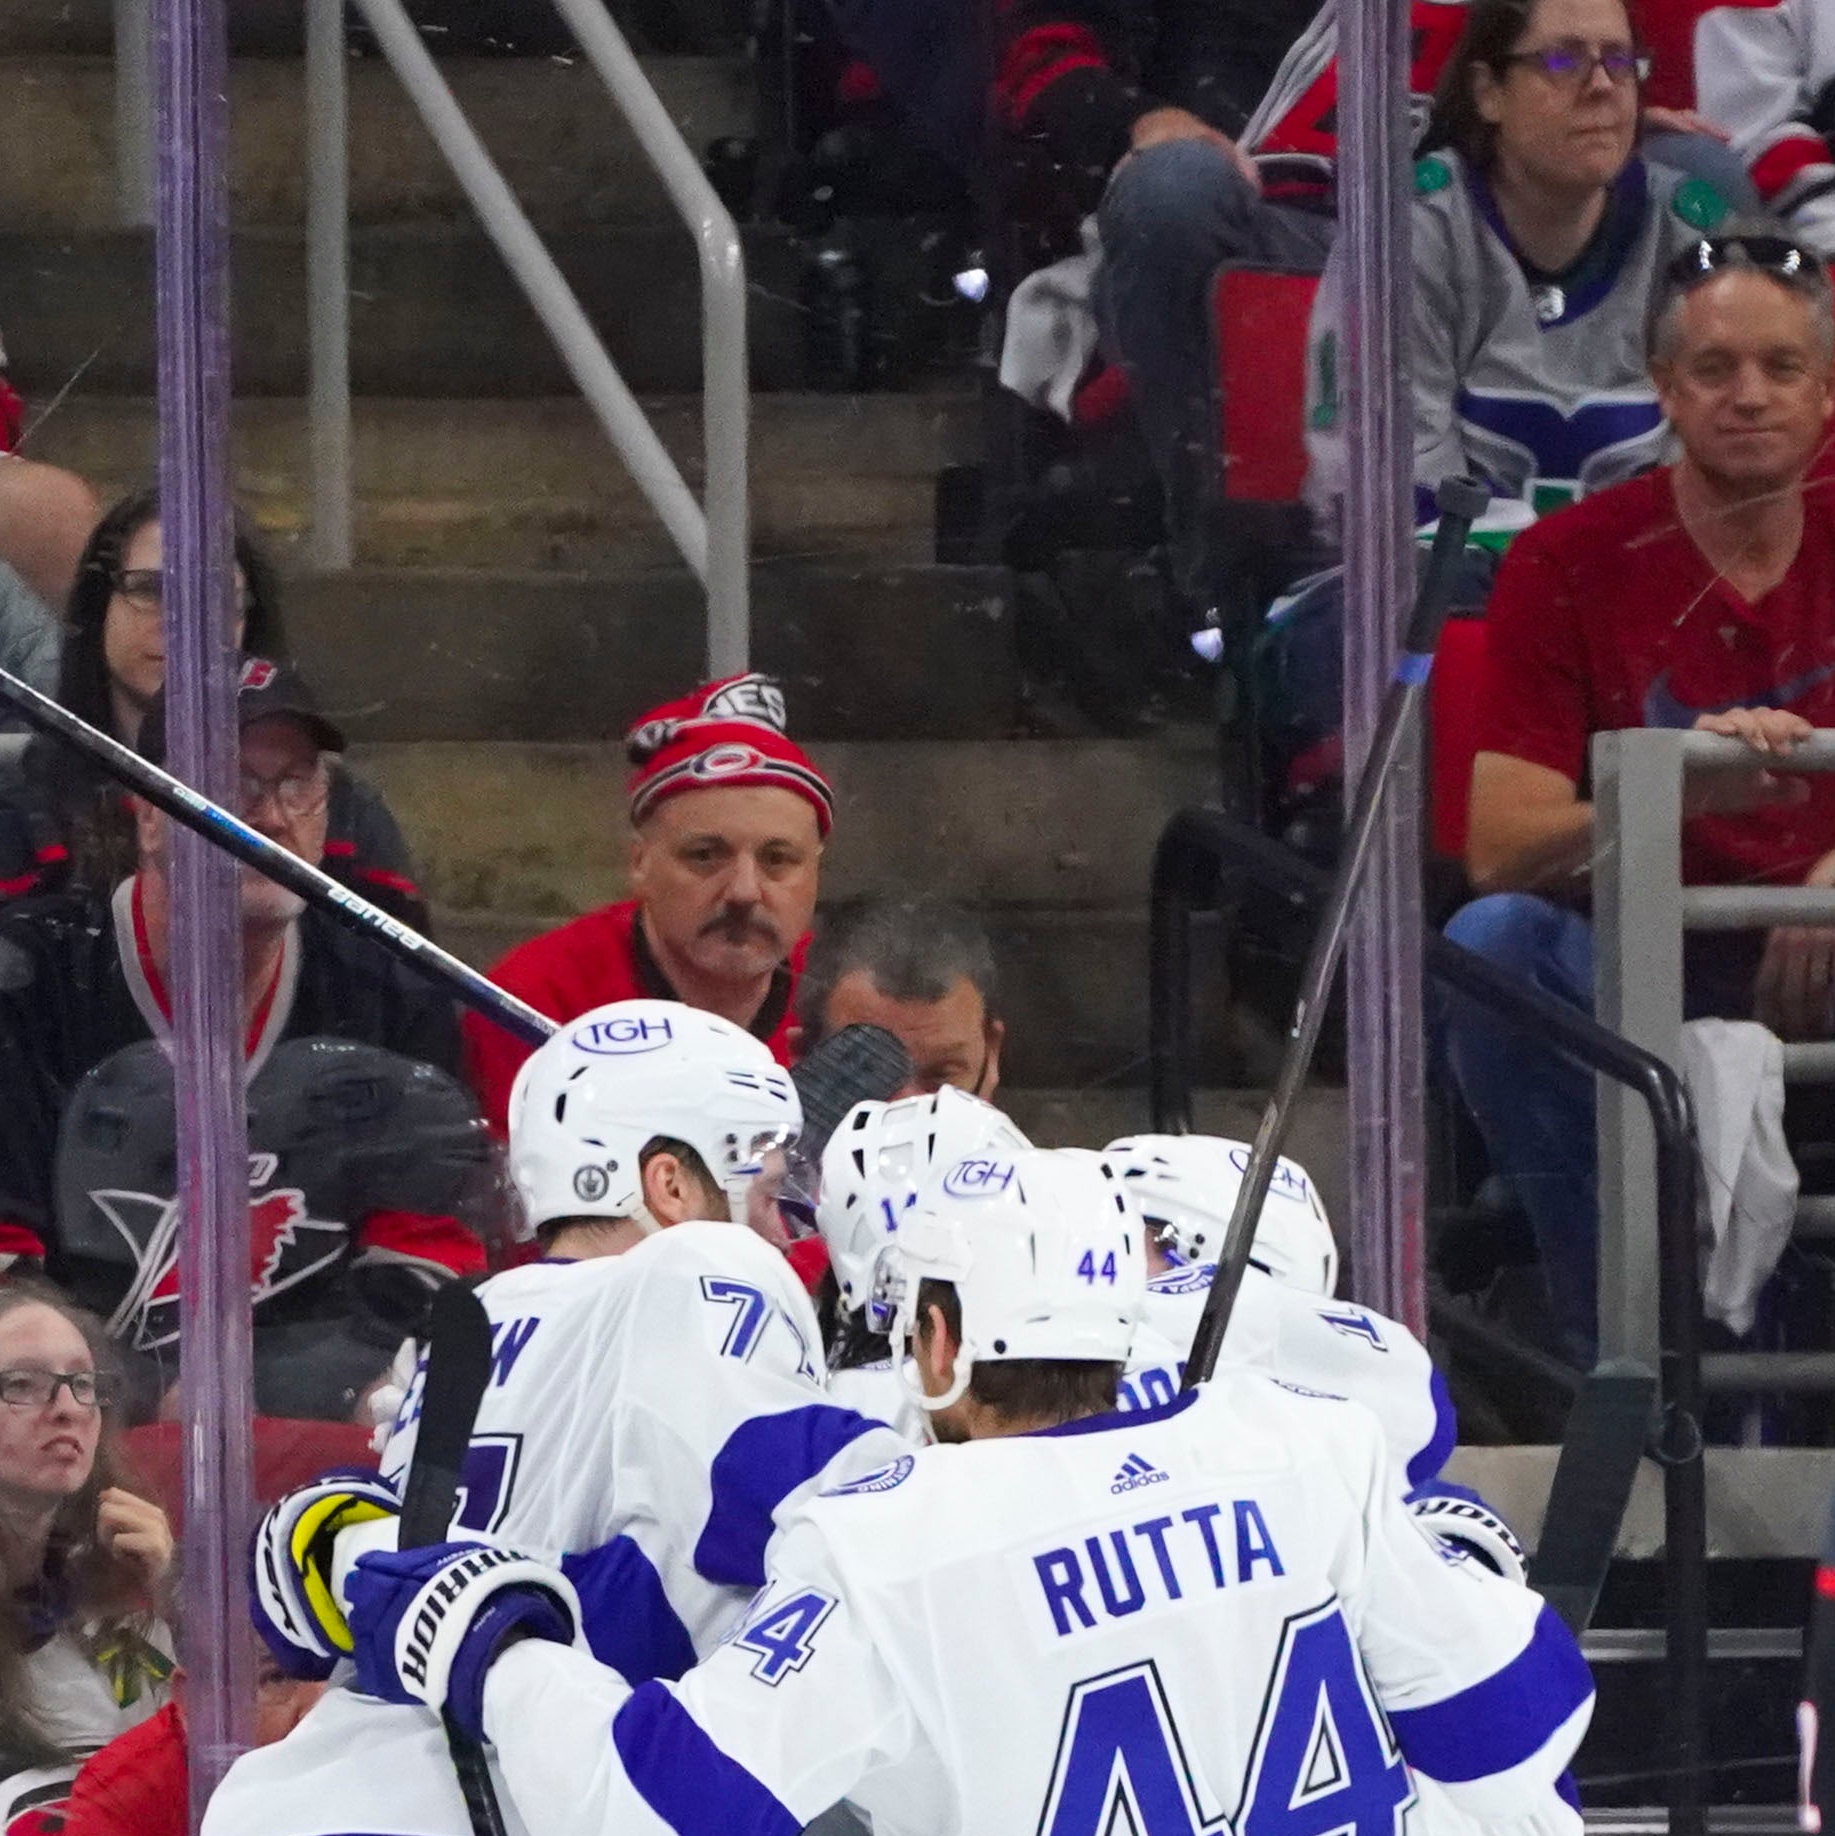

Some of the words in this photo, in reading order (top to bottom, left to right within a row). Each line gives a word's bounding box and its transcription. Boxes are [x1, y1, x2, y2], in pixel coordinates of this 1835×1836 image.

[585, 1016, 674, 1046] TGH
[952, 1159, 1016, 1192] TGH
[1076, 1248, 1119, 1287] 44
[1110, 1469, 1171, 1495] adidas
[1032, 1499, 1287, 1636] RUTTA
